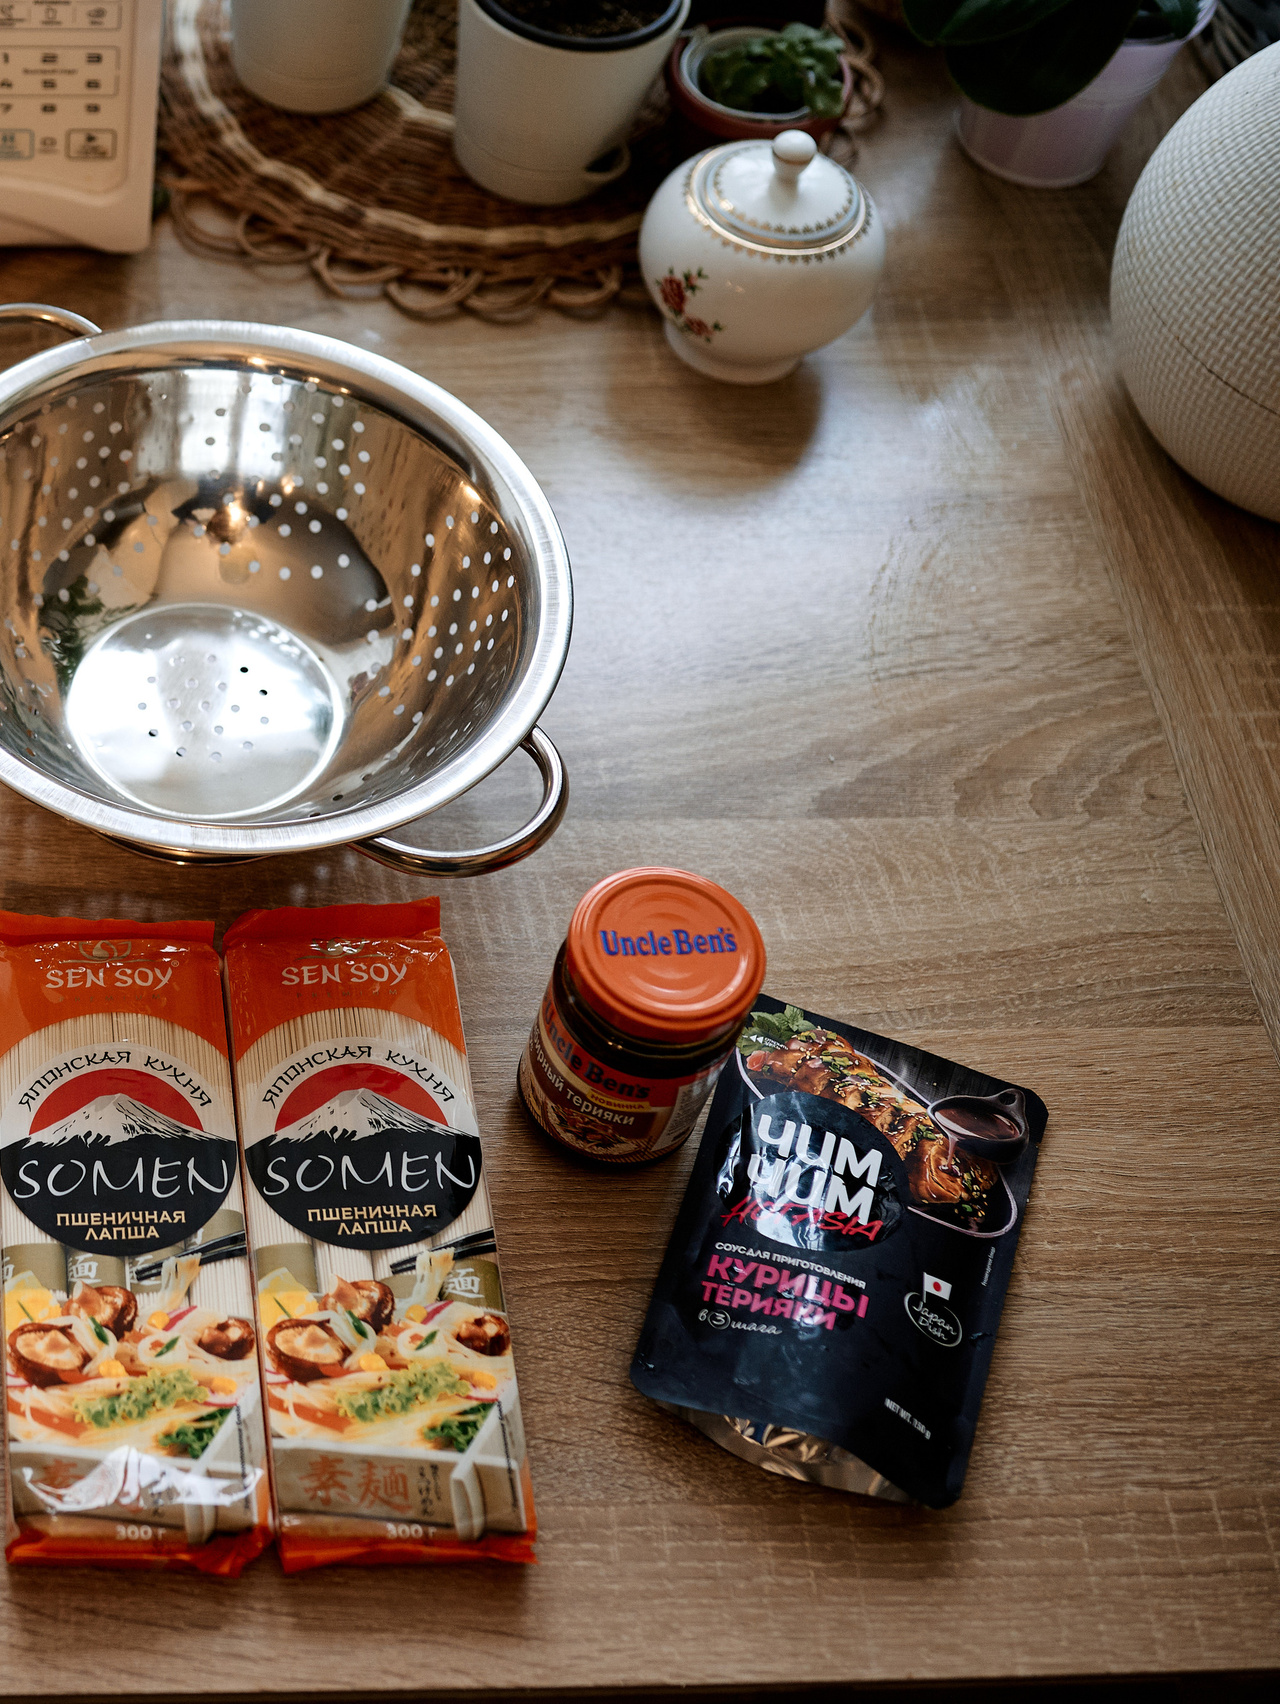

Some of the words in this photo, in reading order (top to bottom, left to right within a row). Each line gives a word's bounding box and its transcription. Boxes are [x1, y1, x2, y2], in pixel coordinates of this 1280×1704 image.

[599, 930, 672, 956] Uncle
[672, 927, 738, 955] Ben's
[45, 967, 107, 989] SEN
[114, 967, 173, 991] SOY
[281, 963, 342, 986] SEN
[349, 962, 408, 987] SOY
[544, 1000, 583, 1070] Uncle
[585, 1061, 651, 1099] Ben's
[18, 1051, 131, 1111] ЯПОНСКАЯ
[143, 1055, 212, 1107] КУХНЯ
[262, 1045, 372, 1109] ЯПОНСКАЯ
[385, 1049, 455, 1102] КУХНЯ
[566, 1088, 636, 1126] терияки
[590, 1093, 645, 1110] НОВИНКА
[757, 1113, 884, 1188] ЧИМ
[13, 1156, 228, 1199] SOMEN
[263, 1151, 476, 1196] SOMEN
[746, 1153, 875, 1226] ЧИМ
[56, 1210, 186, 1226] ПШЕНИЧНАЯ
[307, 1204, 438, 1222] ПШЕНИЧНАЯ
[337, 1219, 413, 1236] ЛАПША
[84, 1226, 160, 1241] ЛАПША
[771, 1252, 867, 1290] ПРИГОТОВЛЕНИЯ
[706, 1254, 870, 1319] КУРИЦЫ
[701, 1280, 838, 1331] ТЕРИЯКИ
[911, 1301, 957, 1335] Japan
[712, 1312, 727, 1326] 3
[731, 1319, 783, 1335] шага
[918, 1316, 948, 1341] Dish
[884, 1397, 901, 1414] NET
[116, 1525, 152, 1540] 300
[386, 1522, 424, 1539] 300
